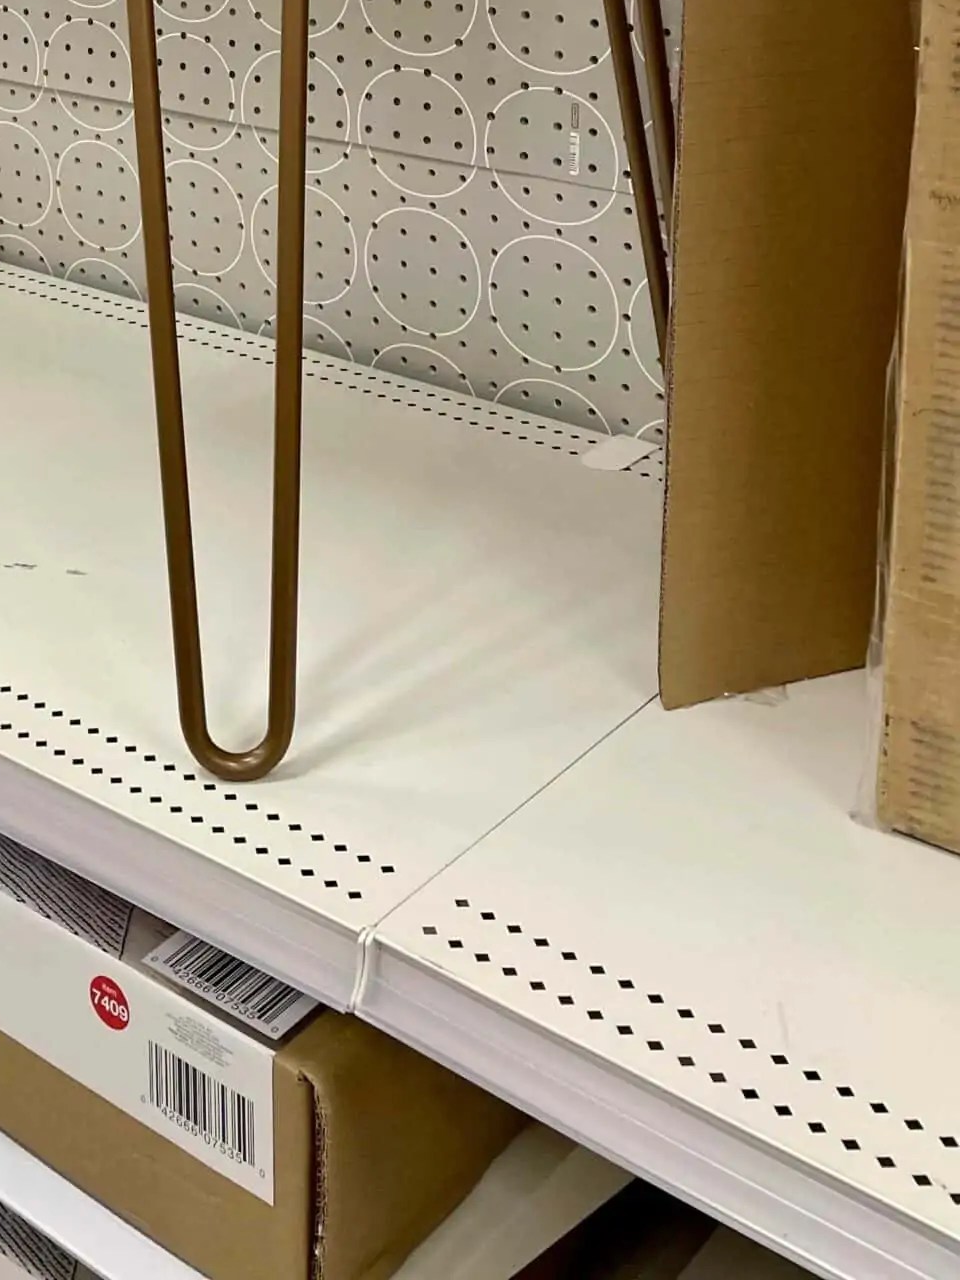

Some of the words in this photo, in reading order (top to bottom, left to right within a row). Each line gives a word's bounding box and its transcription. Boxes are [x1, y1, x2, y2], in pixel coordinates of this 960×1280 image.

[92, 988, 128, 1022] 7409
[172, 969, 212, 994] 42666
[215, 992, 256, 1021] 07535
[160, 1106, 198, 1137] 42666
[204, 1132, 243, 1165] 07535
